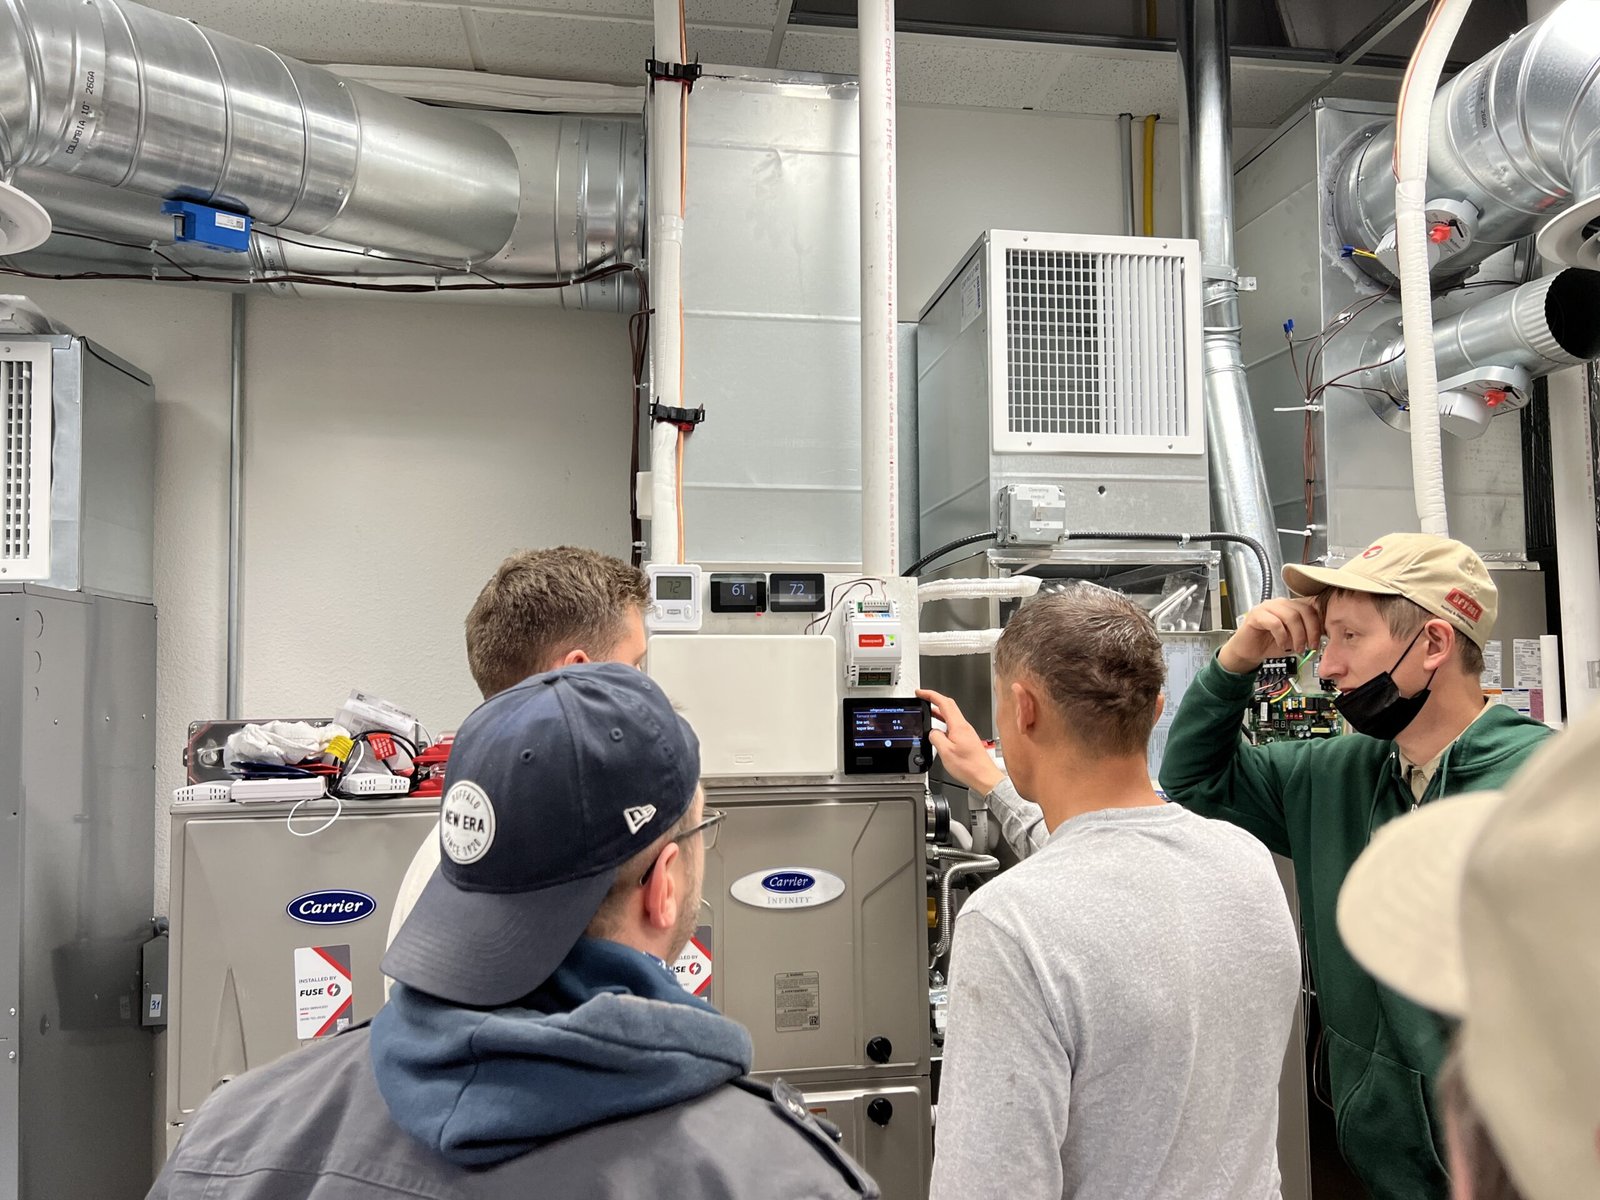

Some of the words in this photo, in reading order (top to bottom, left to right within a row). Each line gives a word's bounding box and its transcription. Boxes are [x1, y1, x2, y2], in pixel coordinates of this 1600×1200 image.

[66, 120, 87, 154] COLUMBIA
[86, 71, 95, 95] 26GA
[667, 581, 681, 594] 72
[732, 584, 746, 596] 61
[790, 584, 804, 596] 72
[1452, 593, 1479, 618] bryant
[452, 790, 481, 809] BUFFALO
[445, 808, 460, 827] NEW
[463, 816, 485, 833] ERA
[445, 832, 460, 856] SINCE
[769, 876, 808, 887] Carrier
[299, 900, 364, 914] Carrier
[300, 988, 324, 996] FUSE
